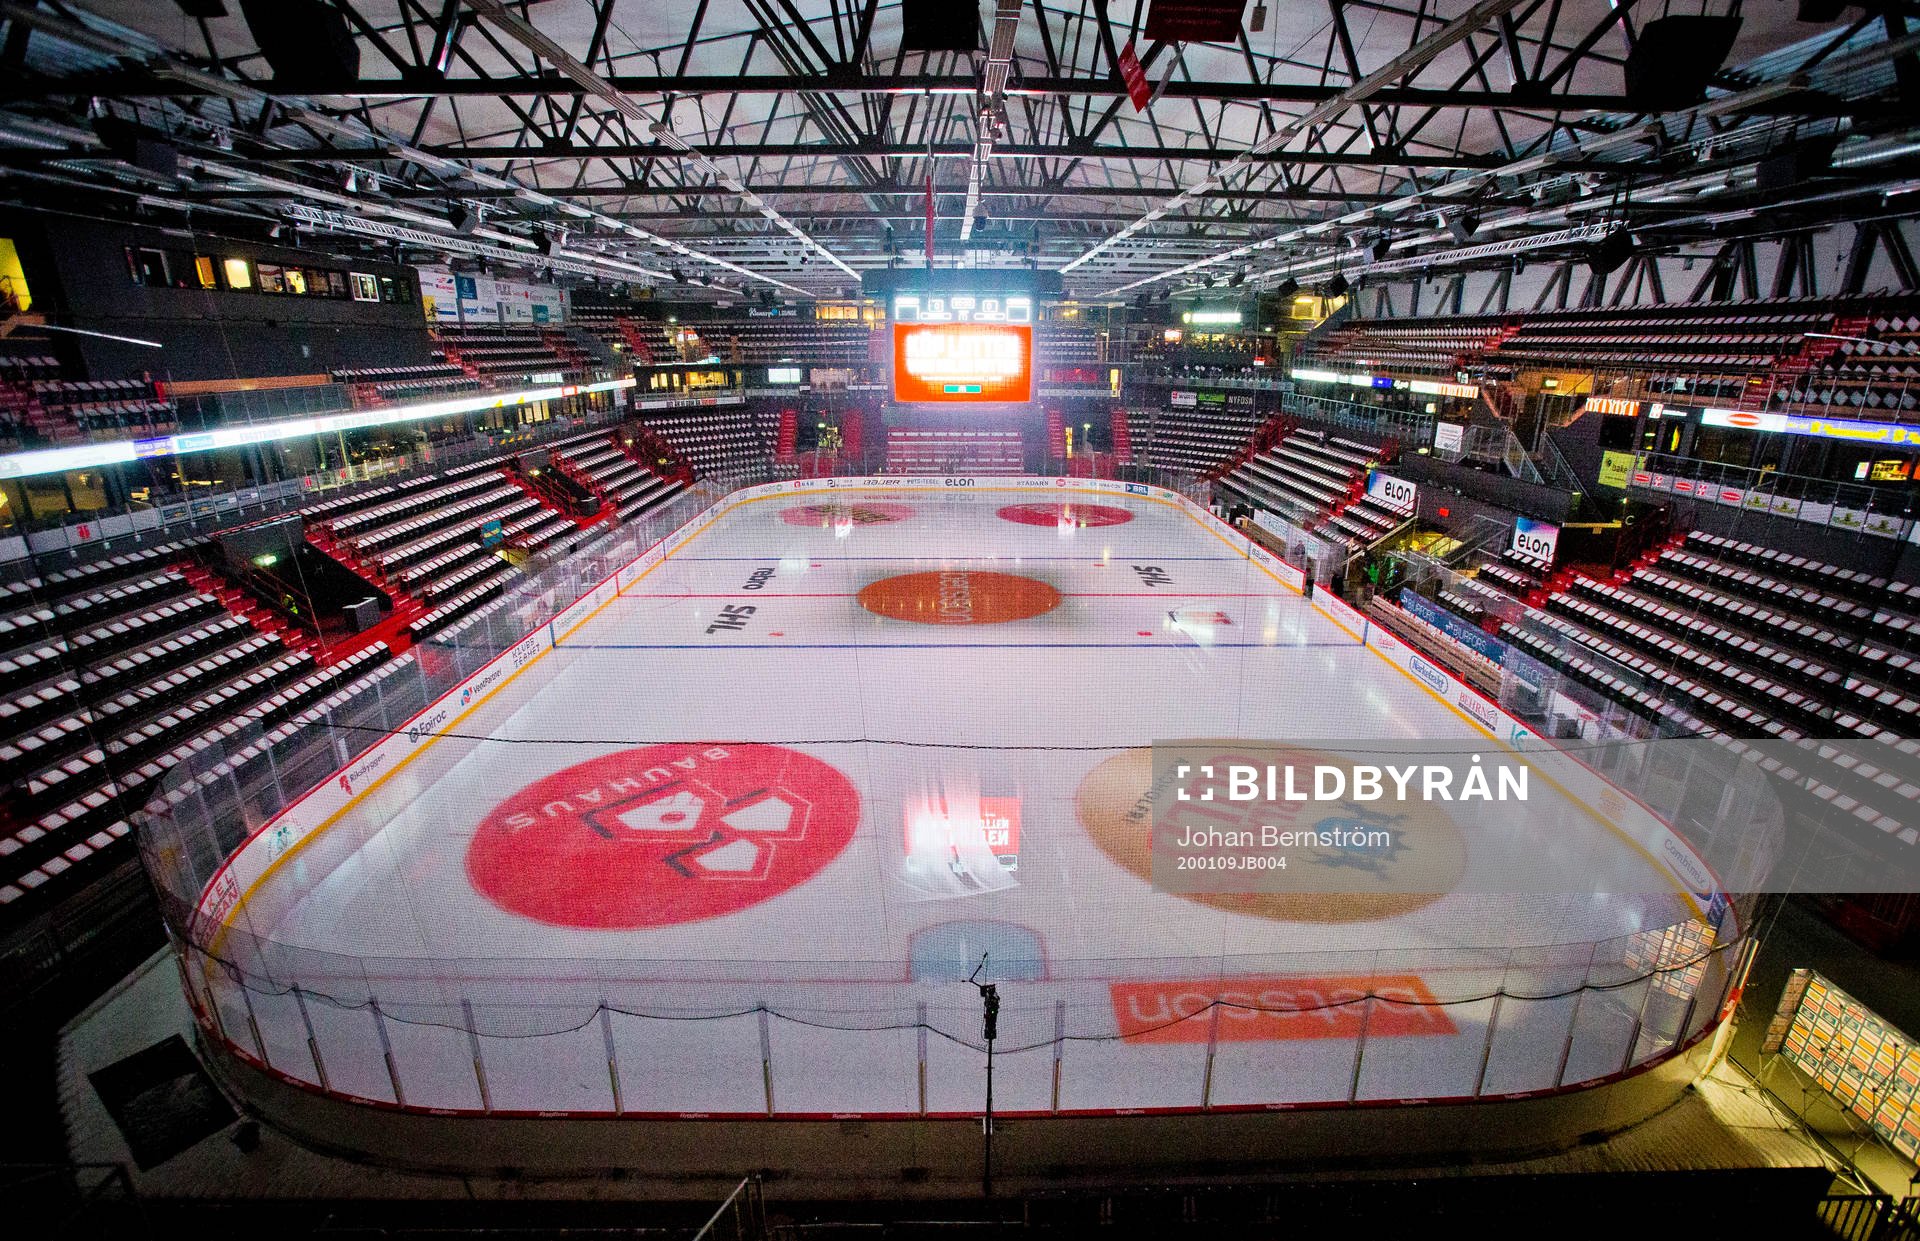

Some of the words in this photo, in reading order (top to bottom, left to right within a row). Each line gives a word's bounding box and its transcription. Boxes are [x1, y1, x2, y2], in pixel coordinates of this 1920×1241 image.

[1228, 394, 1254, 406] NYFOSA
[1131, 485, 1149, 494] BRL
[1131, 564, 1175, 588] SHL
[705, 604, 758, 635] SHL
[418, 709, 448, 736] Epiroc
[503, 747, 733, 829] BAUHAUS
[1127, 980, 1436, 1024] betsson
